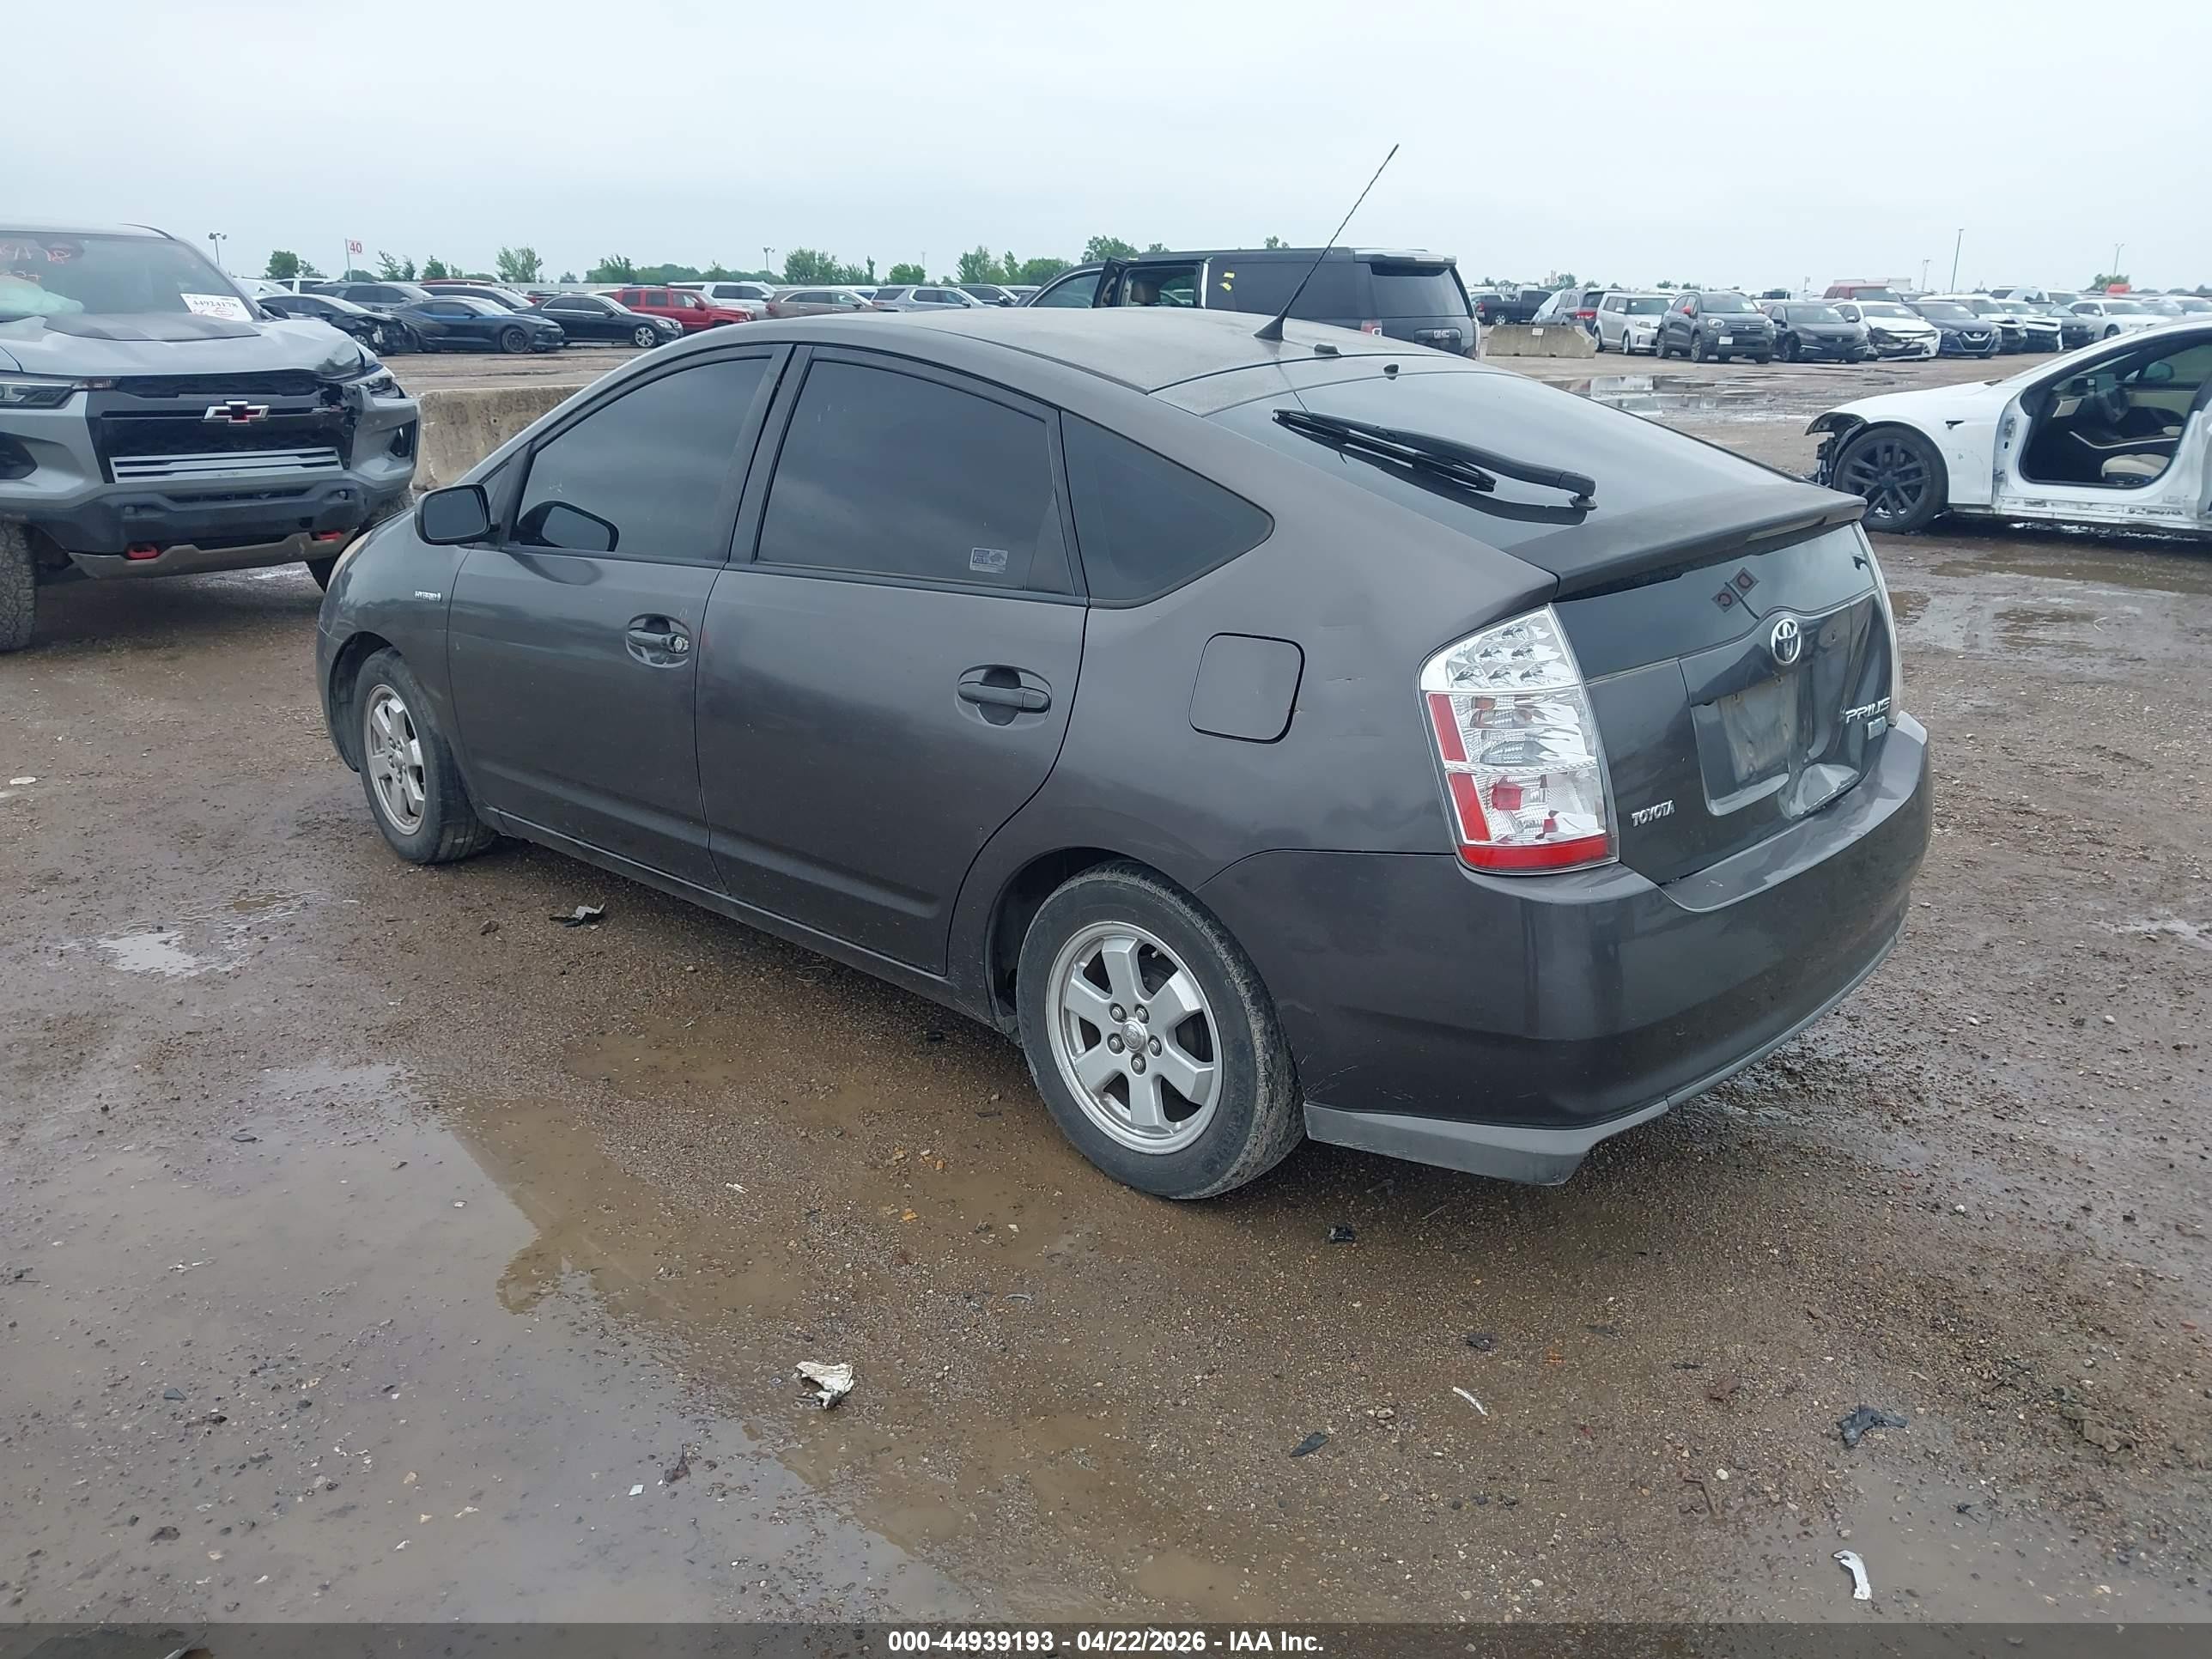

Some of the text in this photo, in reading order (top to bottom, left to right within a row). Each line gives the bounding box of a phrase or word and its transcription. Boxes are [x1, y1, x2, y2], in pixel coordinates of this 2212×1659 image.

[349, 242, 362, 254] 40
[1845, 696, 1891, 724] PRIUS
[1632, 799, 1675, 827] TOYOTA
